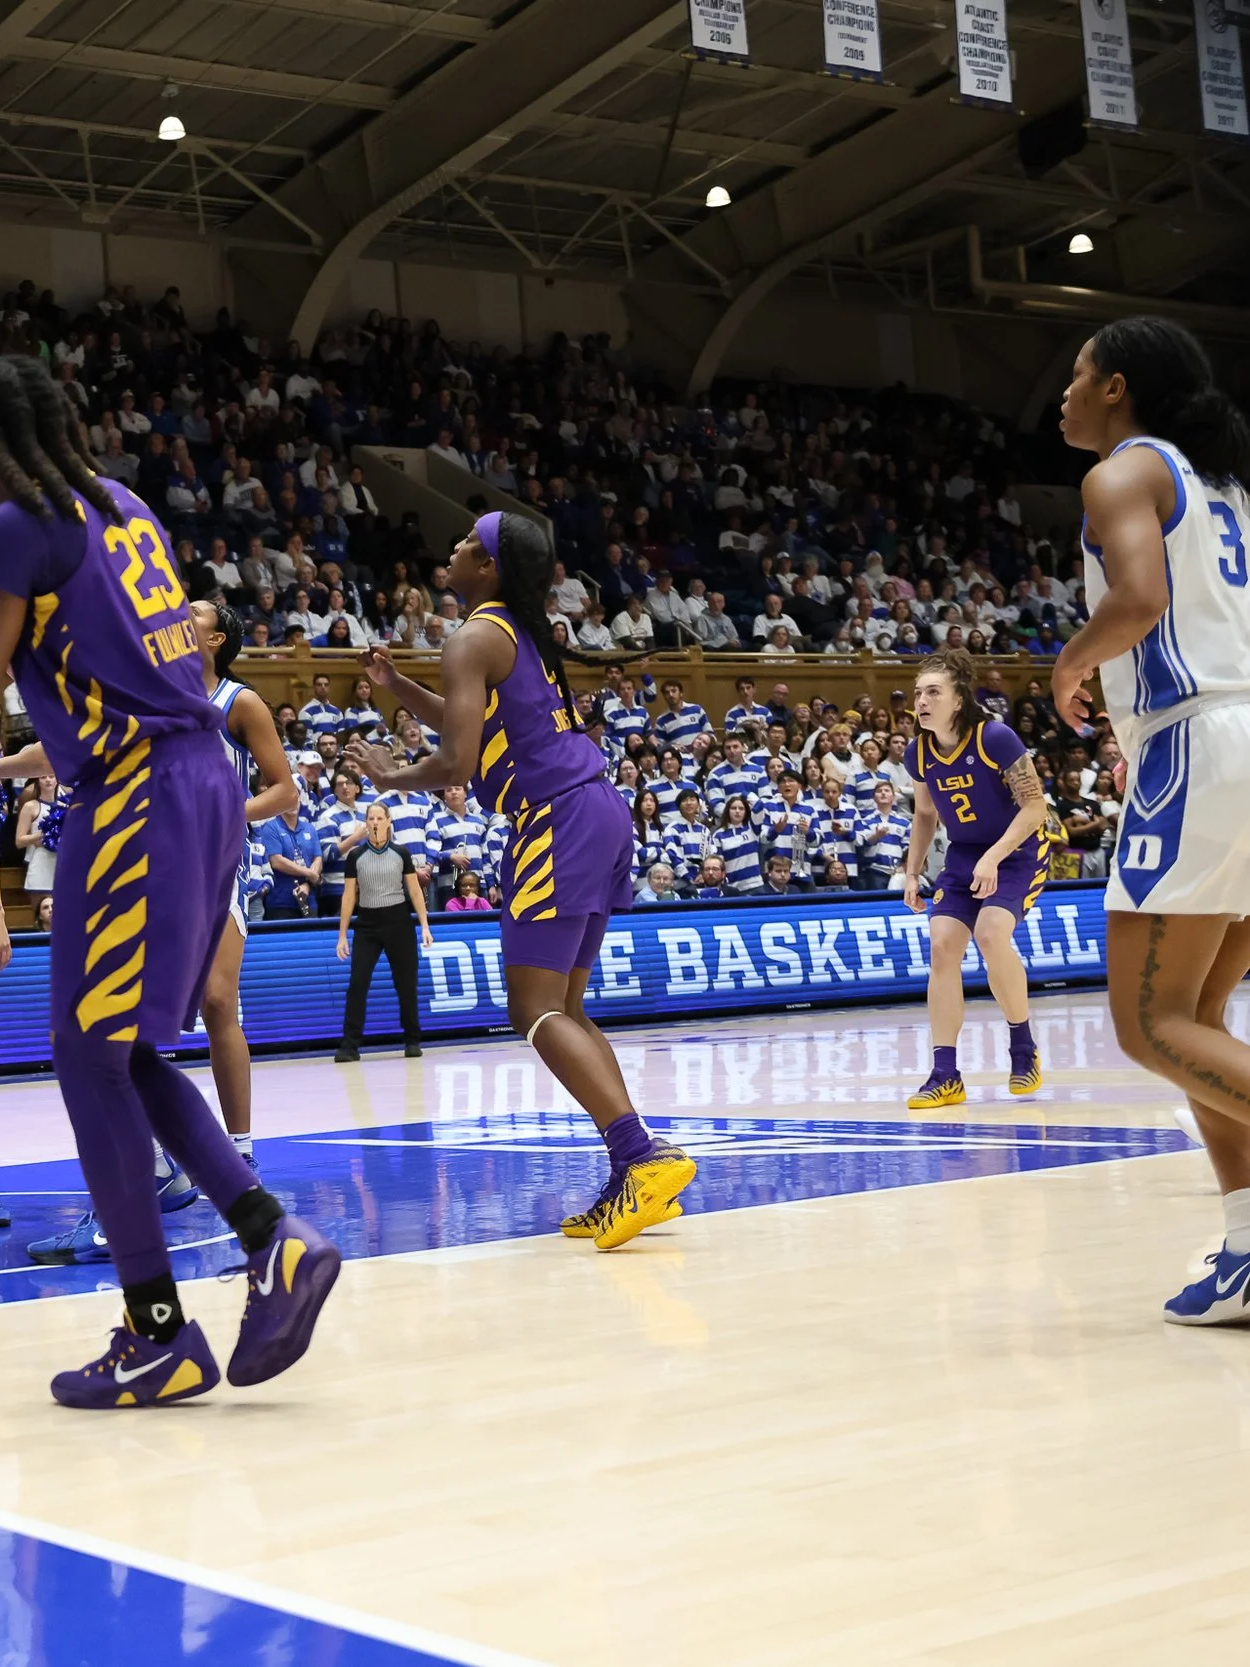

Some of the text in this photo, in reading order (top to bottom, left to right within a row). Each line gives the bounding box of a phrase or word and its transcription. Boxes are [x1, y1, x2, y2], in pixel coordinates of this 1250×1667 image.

[103, 517, 185, 620] 23
[1208, 501, 1249, 588] 3
[936, 773, 975, 791] LSU
[950, 793, 977, 823] 2
